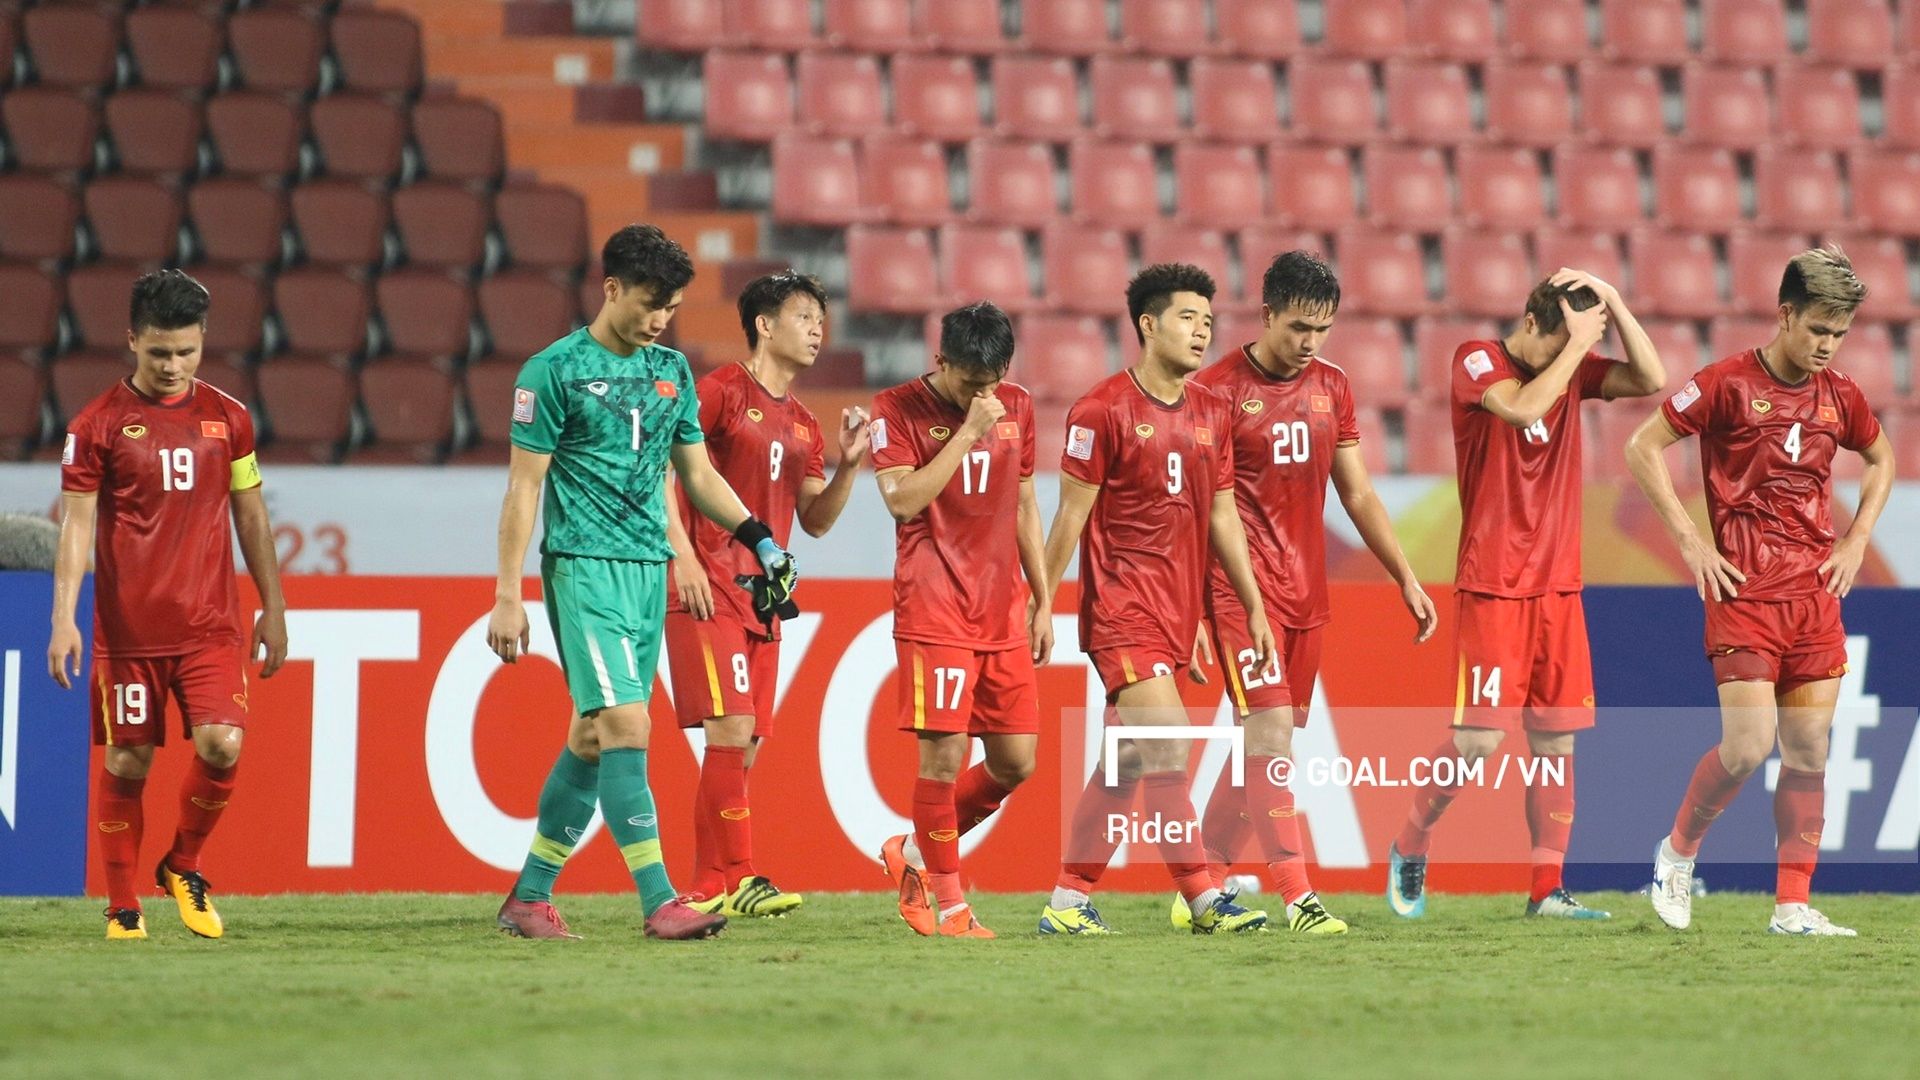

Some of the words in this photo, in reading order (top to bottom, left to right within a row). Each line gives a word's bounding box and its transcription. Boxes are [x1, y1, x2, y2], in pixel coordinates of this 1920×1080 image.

[628, 408, 640, 451] 1
[1272, 421, 1310, 464] 20
[1784, 422, 1802, 463] 4
[158, 447, 194, 491] 19
[769, 440, 784, 482] 8
[961, 450, 991, 495] 17
[1167, 451, 1182, 495] 9
[621, 637, 636, 680] 1
[731, 653, 750, 693] 8
[114, 683, 147, 725] 19
[934, 667, 966, 710] 17
[1472, 666, 1501, 707] 14
[254, 600, 1371, 872] TOYOTA
